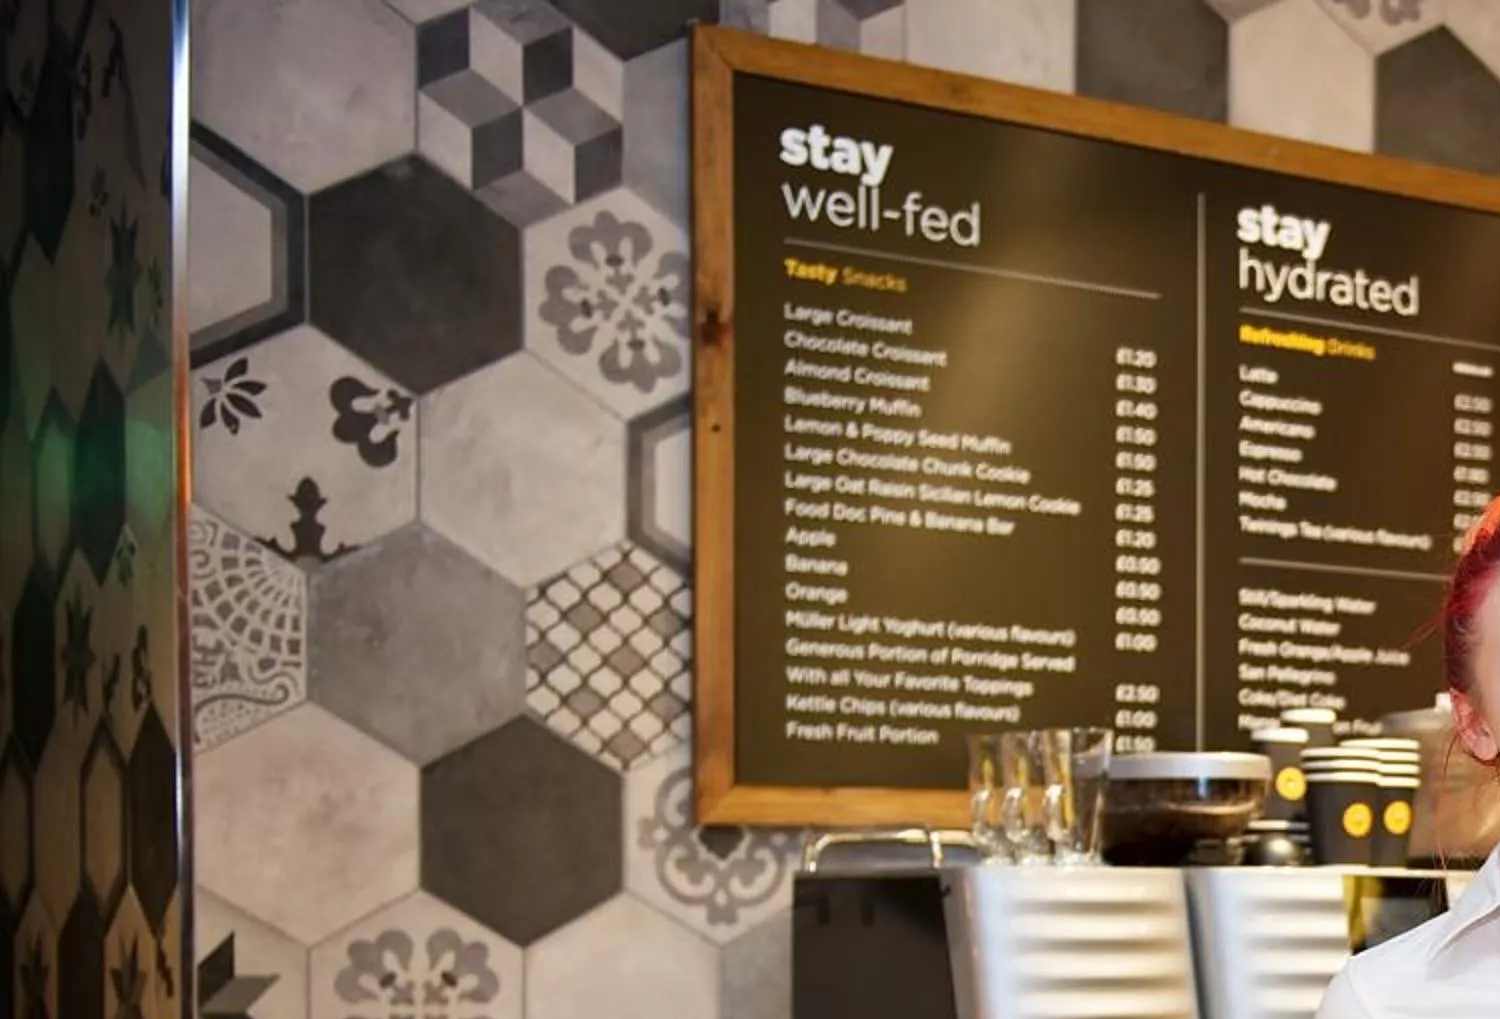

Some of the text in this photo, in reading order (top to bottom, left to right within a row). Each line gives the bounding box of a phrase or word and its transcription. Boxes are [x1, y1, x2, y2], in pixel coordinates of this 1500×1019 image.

[780, 124, 893, 186] stay
[781, 181, 981, 248] well-fed
[1236, 204, 1331, 261] stay
[784, 257, 908, 292] Tasty Snacks
[1238, 246, 1420, 316] hydrated
[784, 302, 913, 335] Large Croissant
[784, 331, 948, 367] Chocolate Croissant
[1239, 324, 1326, 356] Refreshing
[784, 358, 931, 392] Almond Croissant
[1239, 364, 1279, 384] Latte
[784, 386, 922, 417] Blueberry Muffin
[1239, 389, 1323, 416] Cappuccino
[784, 414, 1012, 455] Lemon & Poppy Seed Muffin
[1239, 415, 1317, 439] Americano
[784, 443, 1032, 484] Large Chocolate Chunk Cookie
[784, 470, 832, 492] Large
[835, 475, 865, 494] Oat
[868, 478, 915, 499] Raisin
[974, 489, 1026, 510] Lemon
[1028, 494, 1082, 516] Cookie
[784, 498, 830, 519] Food
[909, 509, 923, 528] &
[925, 512, 984, 533] Banana
[986, 516, 1016, 536] Bar
[784, 525, 837, 548] Apple
[785, 553, 849, 576] Banana
[785, 581, 849, 606] Orange
[837, 612, 881, 635] Light
[883, 616, 946, 638] Yoghurt
[947, 620, 1009, 642] (various
[785, 636, 1077, 673] Generous Portion of Porridge Served
[785, 665, 1035, 699] With all Your Favorite Toppings
[785, 692, 1022, 724] Kettle Chips (various flavours)
[785, 720, 940, 745] Fresh Fruit Portion
